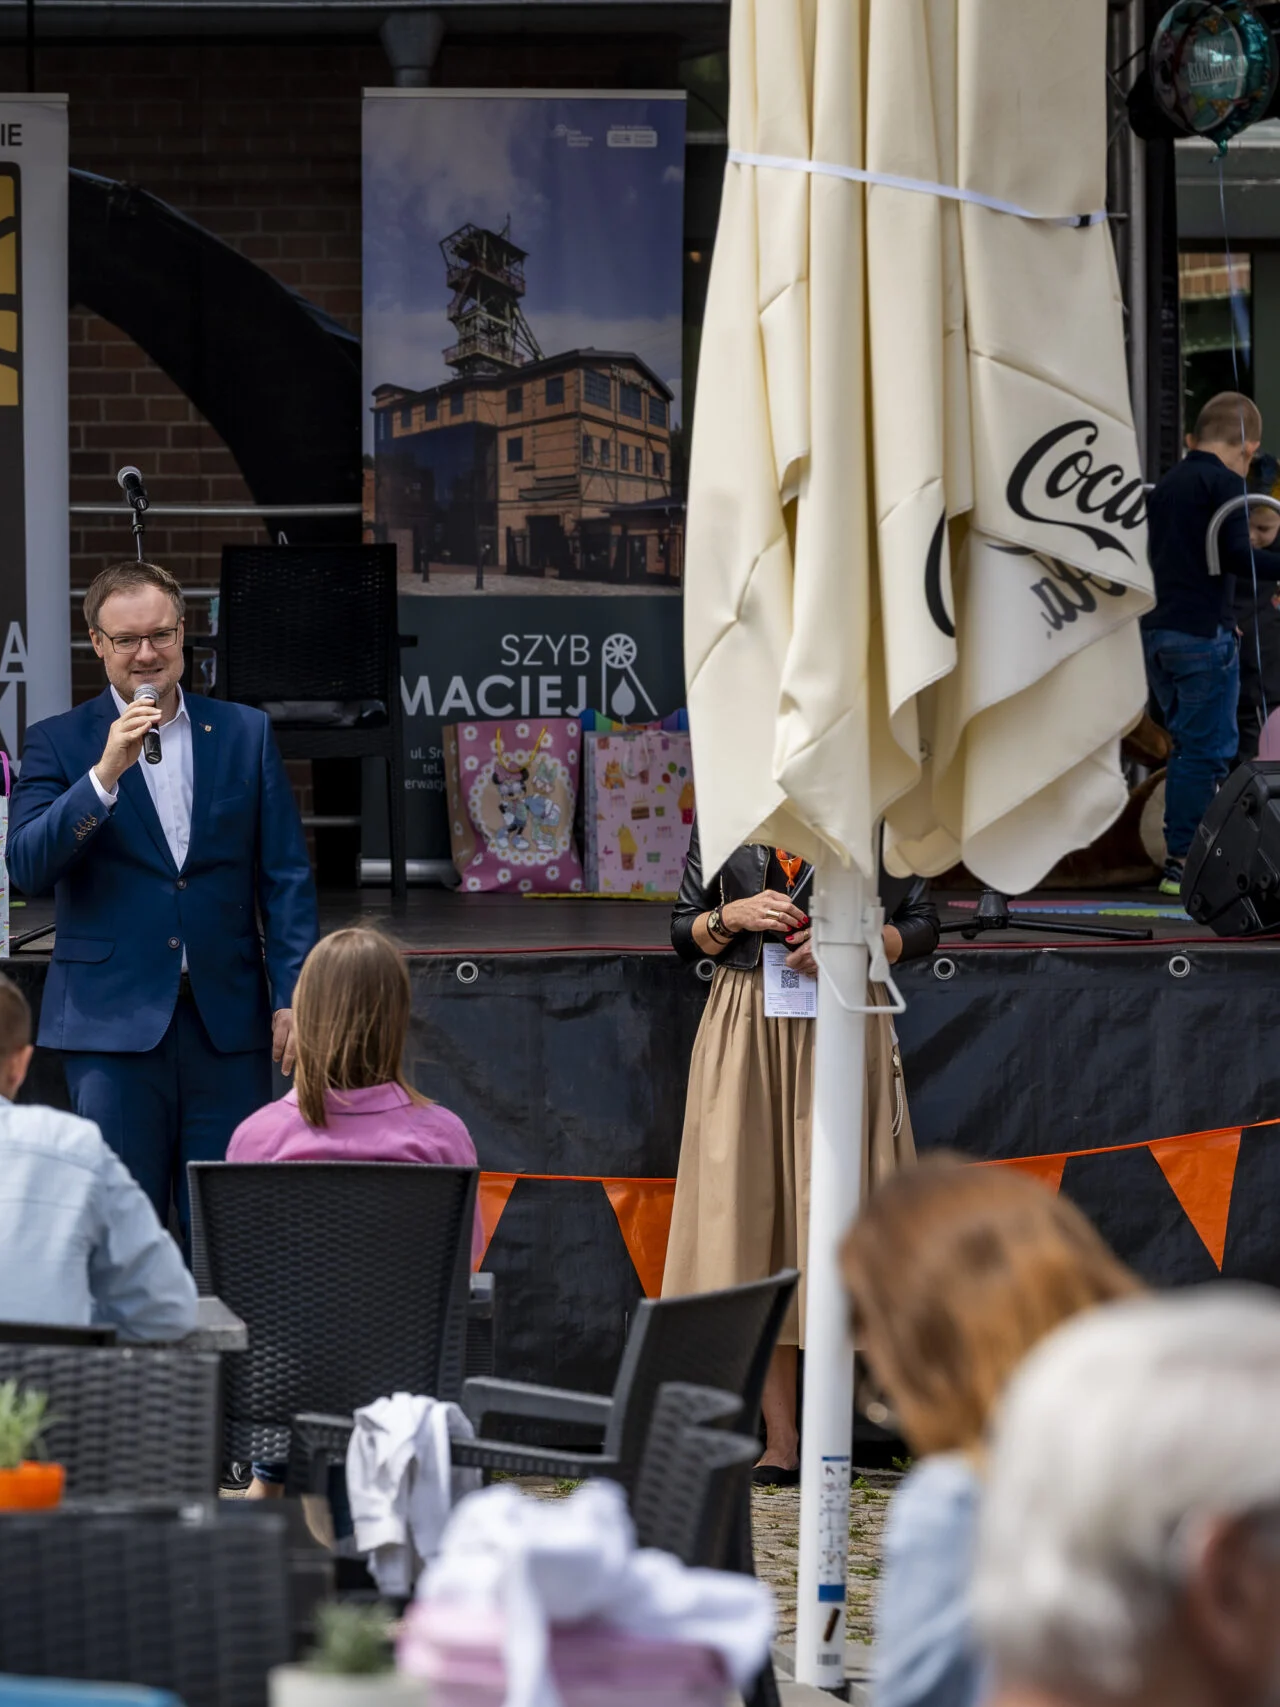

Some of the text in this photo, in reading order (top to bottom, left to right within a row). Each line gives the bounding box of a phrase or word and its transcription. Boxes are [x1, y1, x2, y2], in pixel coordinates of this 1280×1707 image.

[1006, 419, 1148, 565] Coca
[500, 633, 591, 666] SZYB
[400, 674, 587, 717] MACIEJ
[410, 746, 426, 760] ul.
[422, 762, 442, 775] tel.
